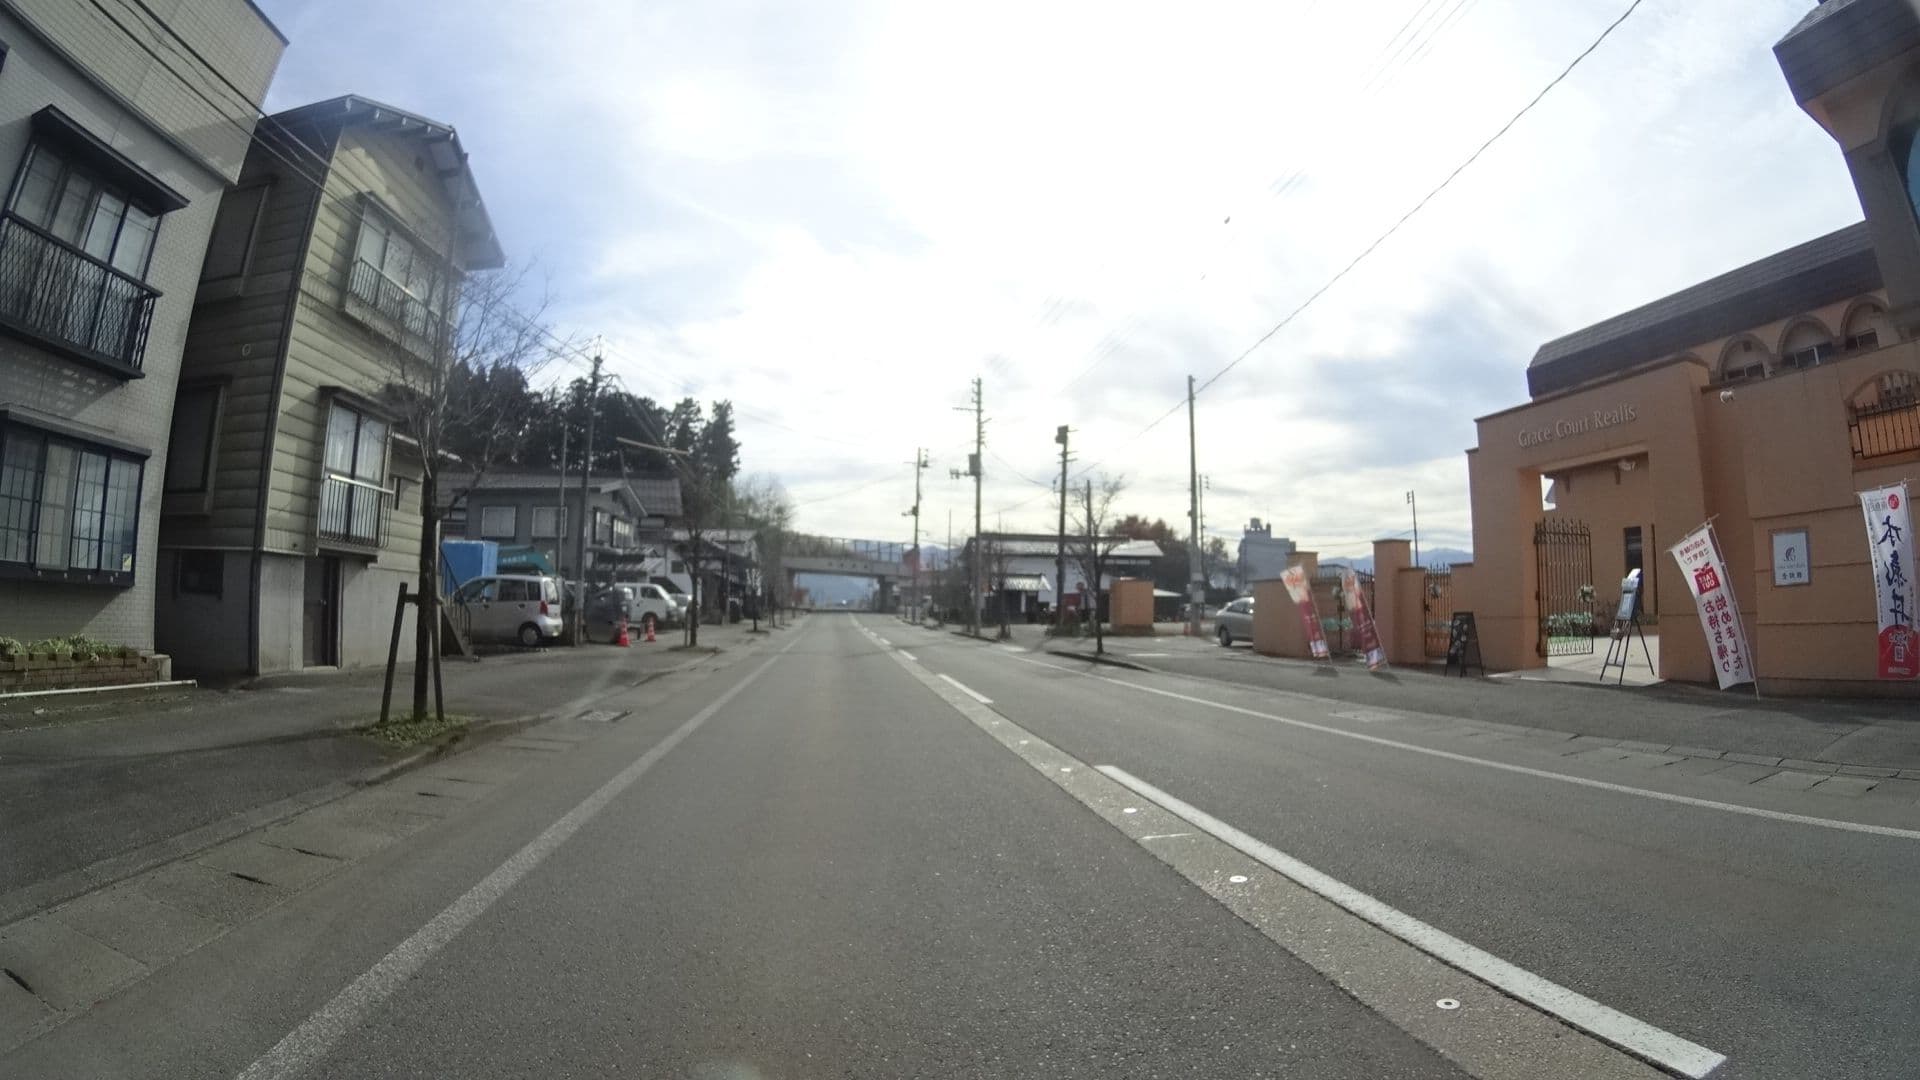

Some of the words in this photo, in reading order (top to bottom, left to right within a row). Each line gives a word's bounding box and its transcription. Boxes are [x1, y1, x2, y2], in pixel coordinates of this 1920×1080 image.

[1518, 428, 1552, 448] Grace
[1556, 416, 1589, 439] Court
[1593, 402, 1636, 429] Realis
